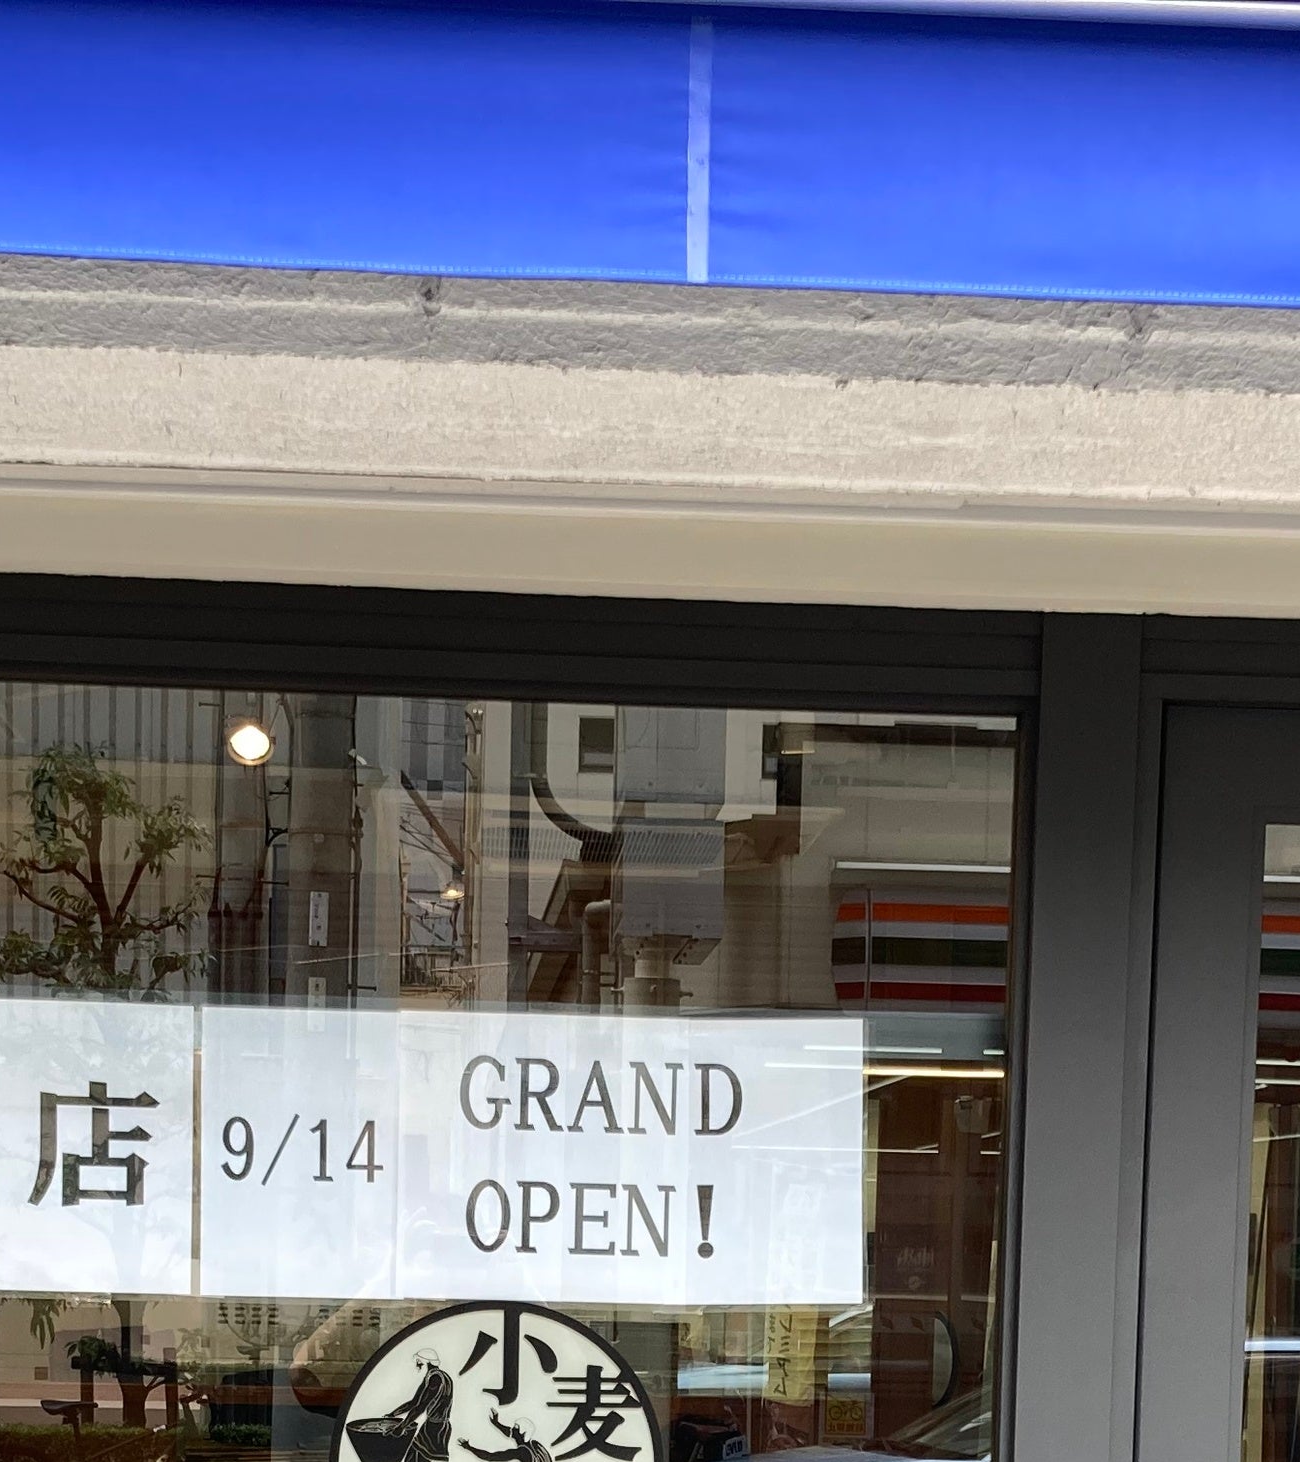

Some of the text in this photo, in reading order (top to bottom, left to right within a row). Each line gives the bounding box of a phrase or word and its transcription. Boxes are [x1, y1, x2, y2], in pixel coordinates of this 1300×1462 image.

[459, 1055, 743, 1136] GRAND
[220, 1113, 384, 1186] 9/14
[465, 1179, 714, 1259] OPEN!
